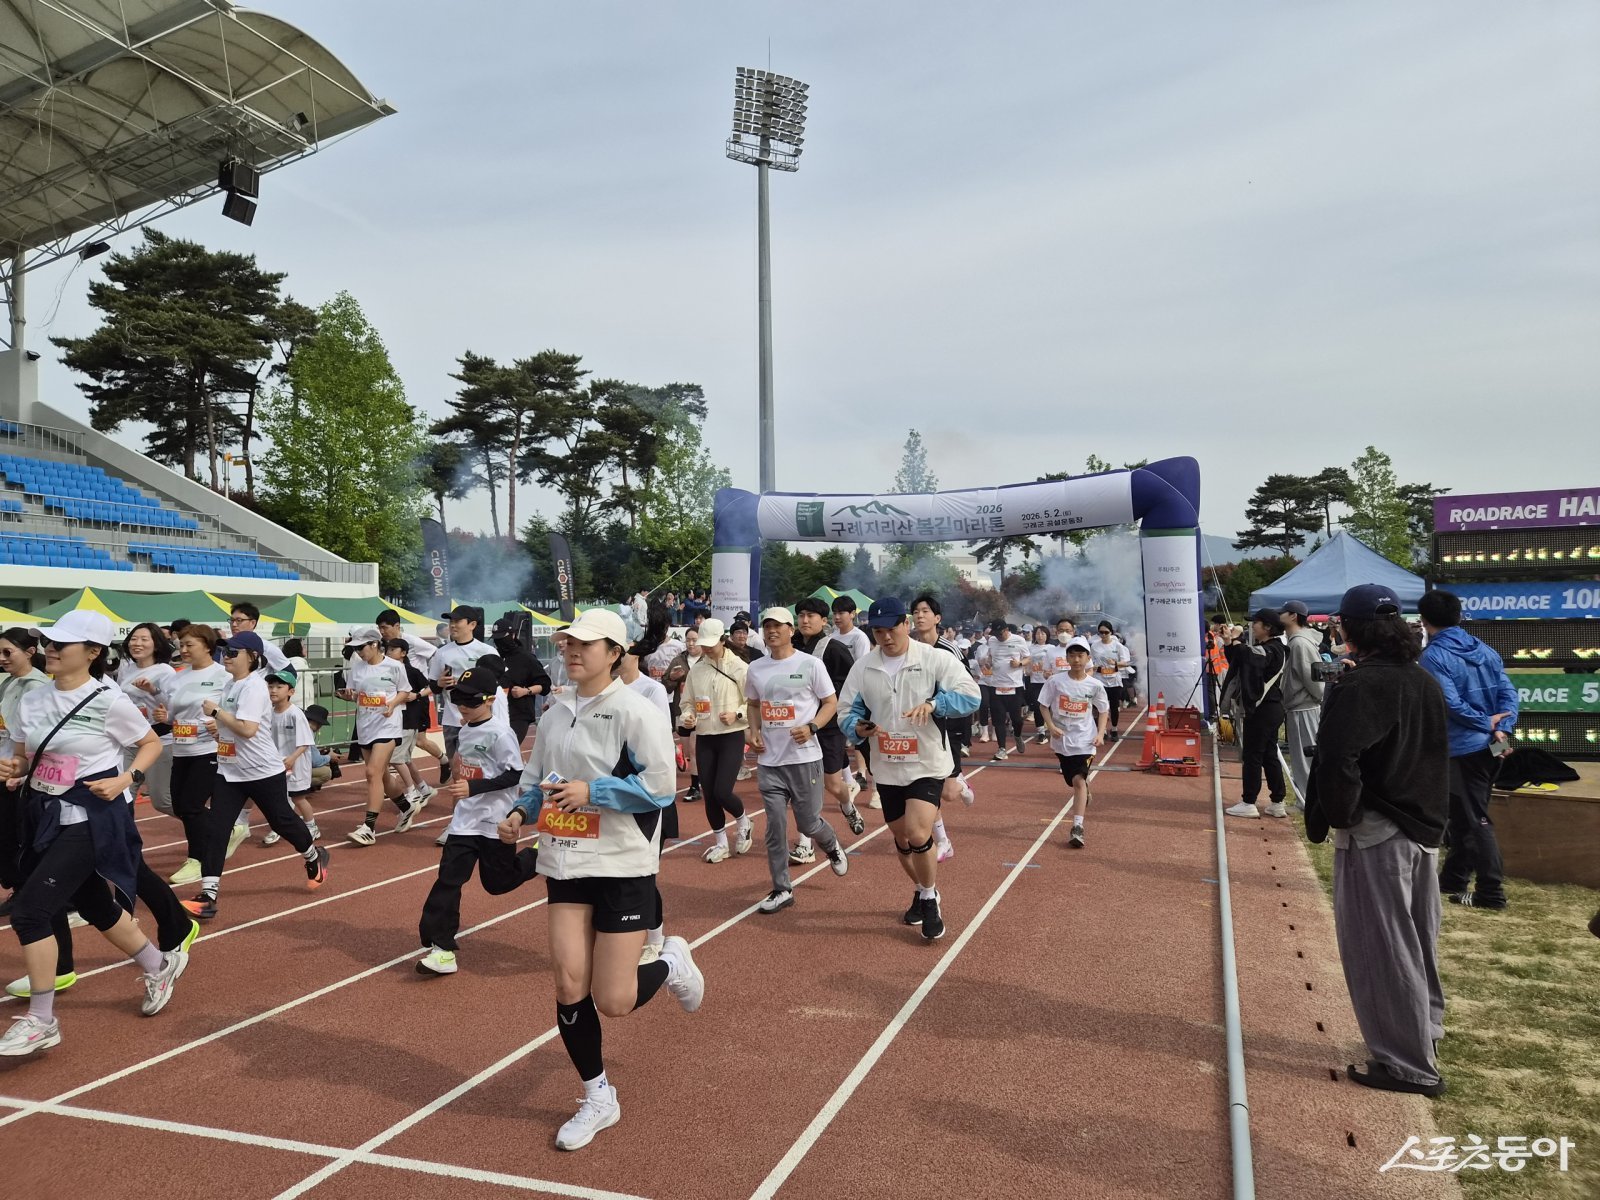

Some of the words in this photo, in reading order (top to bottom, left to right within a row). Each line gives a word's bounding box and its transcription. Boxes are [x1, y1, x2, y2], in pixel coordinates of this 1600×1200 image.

[976, 504, 1003, 515] 2026
[1449, 504, 1549, 523] ROADRACE
[1022, 521, 1045, 530] 구례군
[1458, 595, 1551, 611] ROADRACE
[119, 627, 132, 636] RE
[1166, 645, 1186, 653] 구례군
[461, 671, 472, 682] P
[1517, 687, 1569, 703] RACE
[1581, 682, 1600, 704] 5
[696, 702, 704, 711] 31
[1063, 701, 1083, 711] 5285
[765, 707, 789, 718] 5409
[883, 740, 910, 751] 5279
[36, 763, 62, 782] 9101
[545, 812, 588, 832] 6443
[558, 839, 578, 849] 구례군
